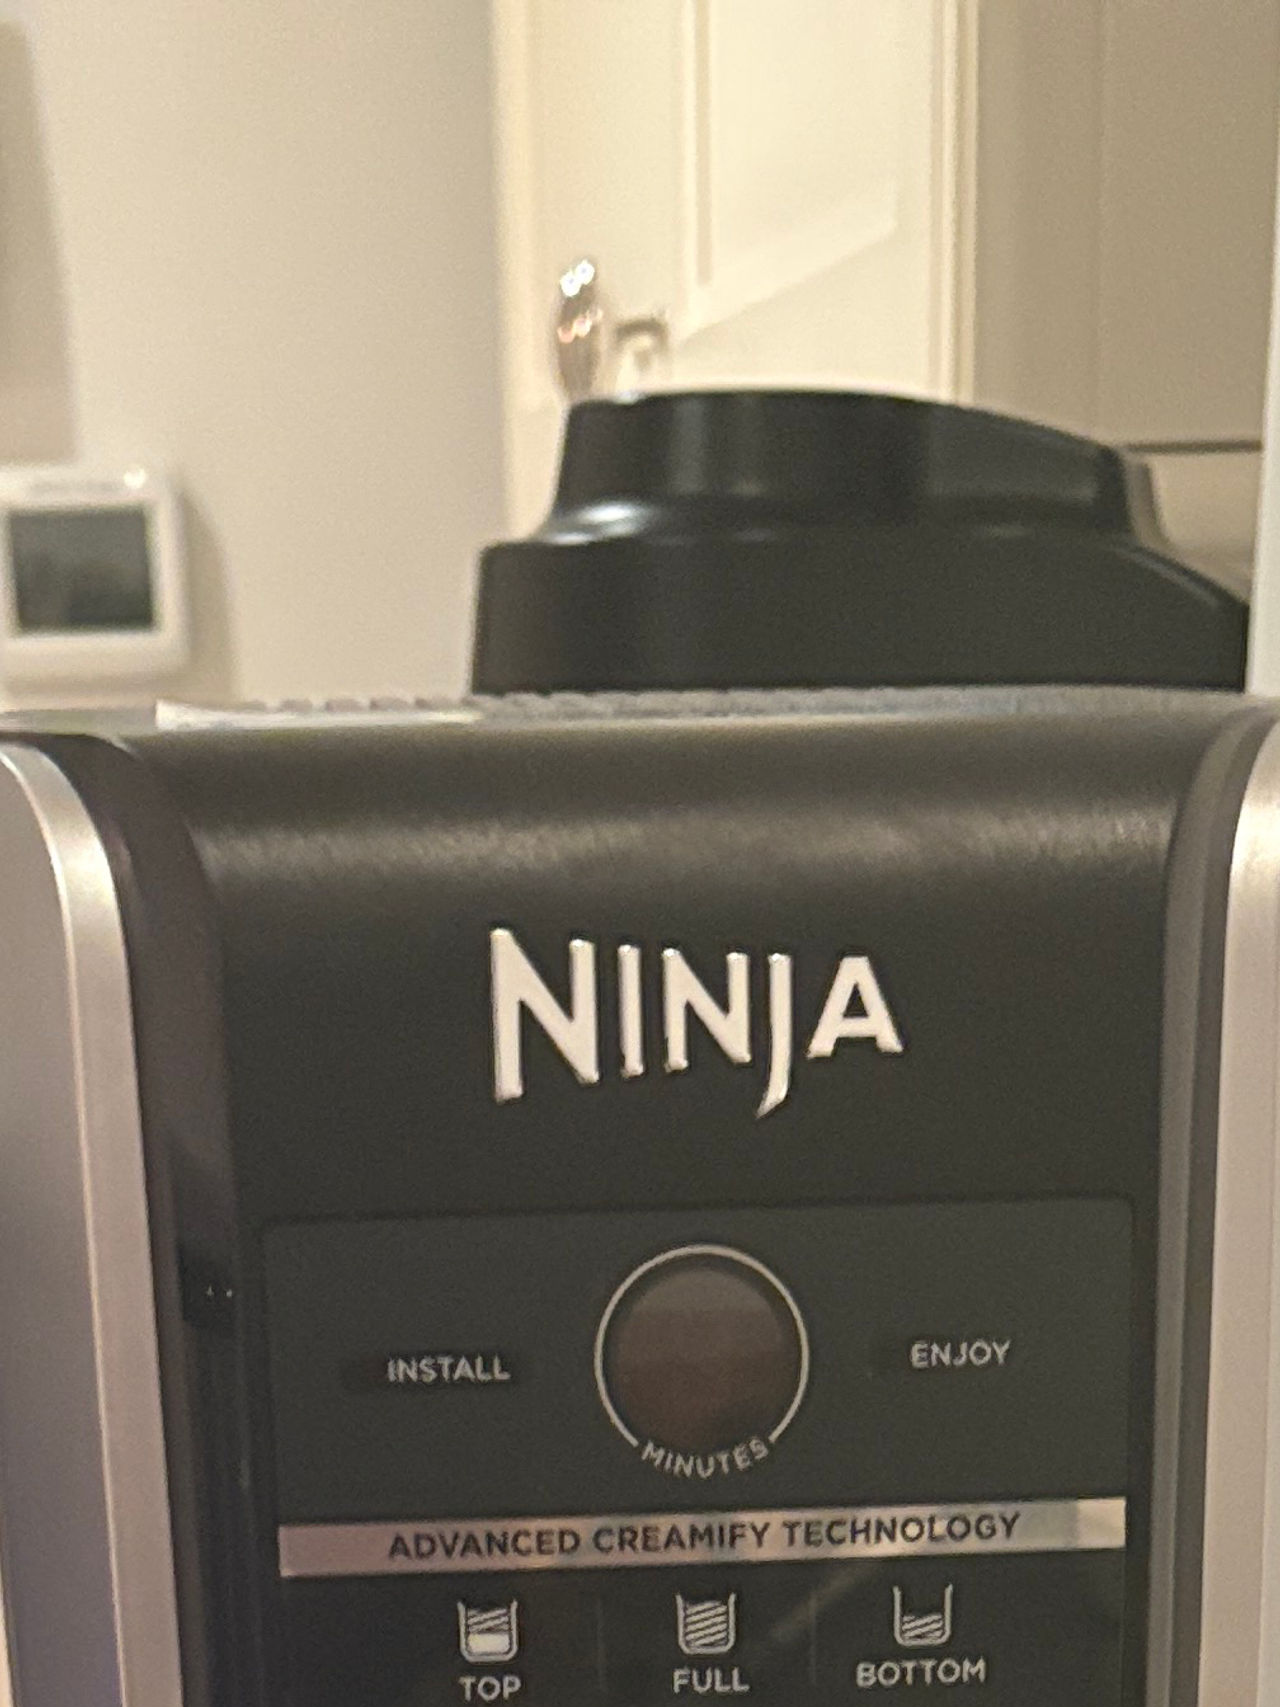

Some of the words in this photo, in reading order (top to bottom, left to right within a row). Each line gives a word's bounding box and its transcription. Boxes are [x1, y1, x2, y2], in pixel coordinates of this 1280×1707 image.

[489, 927, 903, 1116] NINJA
[911, 1339, 1011, 1368] ENJOY
[387, 1355, 510, 1384] INSTALL
[640, 1437, 770, 1480] MINUTES
[388, 1529, 581, 1560] ADVANCED
[592, 1523, 770, 1554] CREAMIFY
[783, 1512, 1021, 1547] TECHNOLOGY
[673, 1667, 750, 1694] FULL
[856, 1658, 986, 1687] BOTTOM
[459, 1674, 521, 1703] TOP
